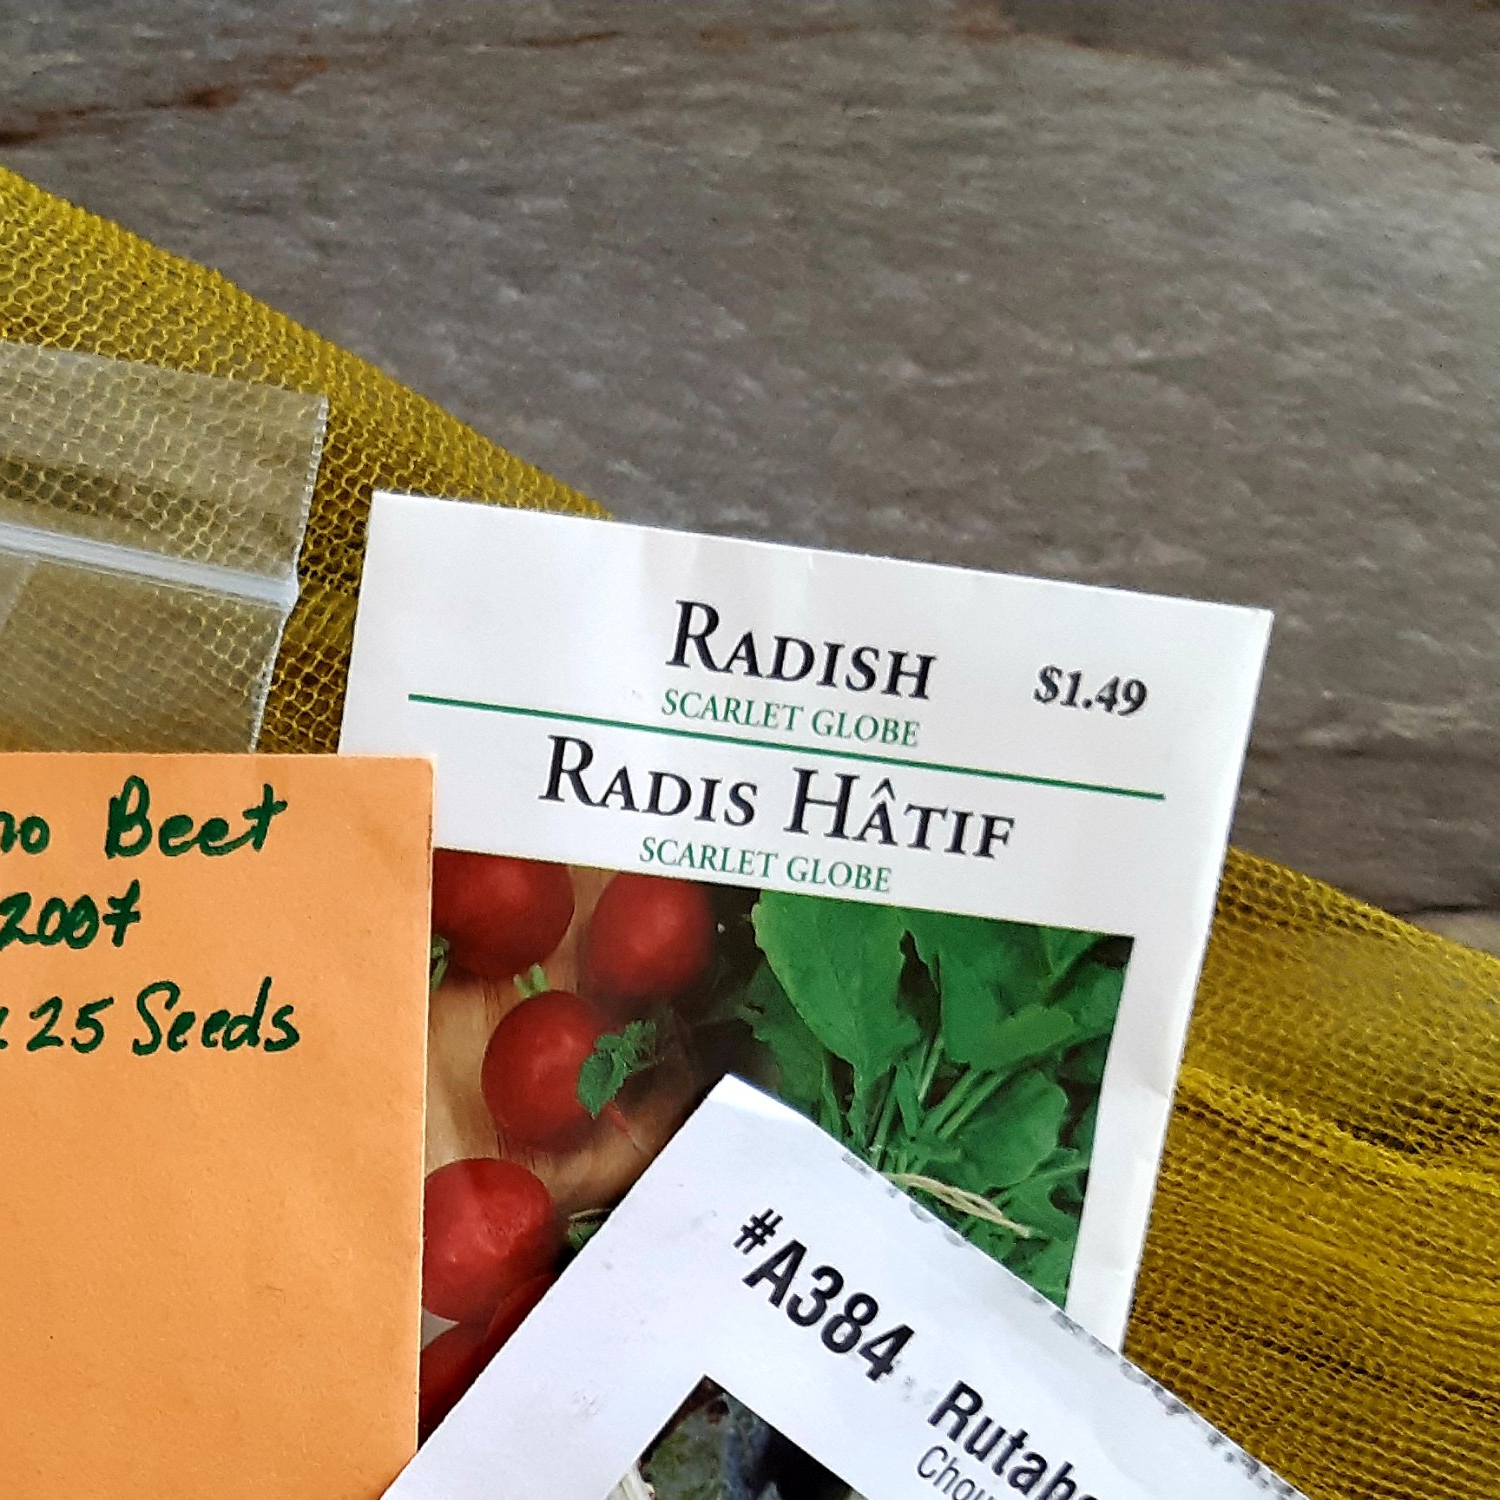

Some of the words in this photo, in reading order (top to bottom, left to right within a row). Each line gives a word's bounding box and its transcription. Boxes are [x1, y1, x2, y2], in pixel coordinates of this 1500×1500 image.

[666, 600, 938, 702] RADISH
[1033, 665, 1148, 717] $1.49
[661, 687, 800, 733] SCARLET
[812, 706, 920, 748] GLOBE
[105, 774, 288, 859] Beet
[538, 736, 759, 828] RADIS
[783, 766, 1016, 860] HÂTIF
[639, 836, 777, 881] SCARLET
[788, 854, 892, 895] GLOBE
[26, 994, 114, 1054] 25
[132, 976, 301, 1056] Seeds
[734, 1208, 915, 1381] #A384
